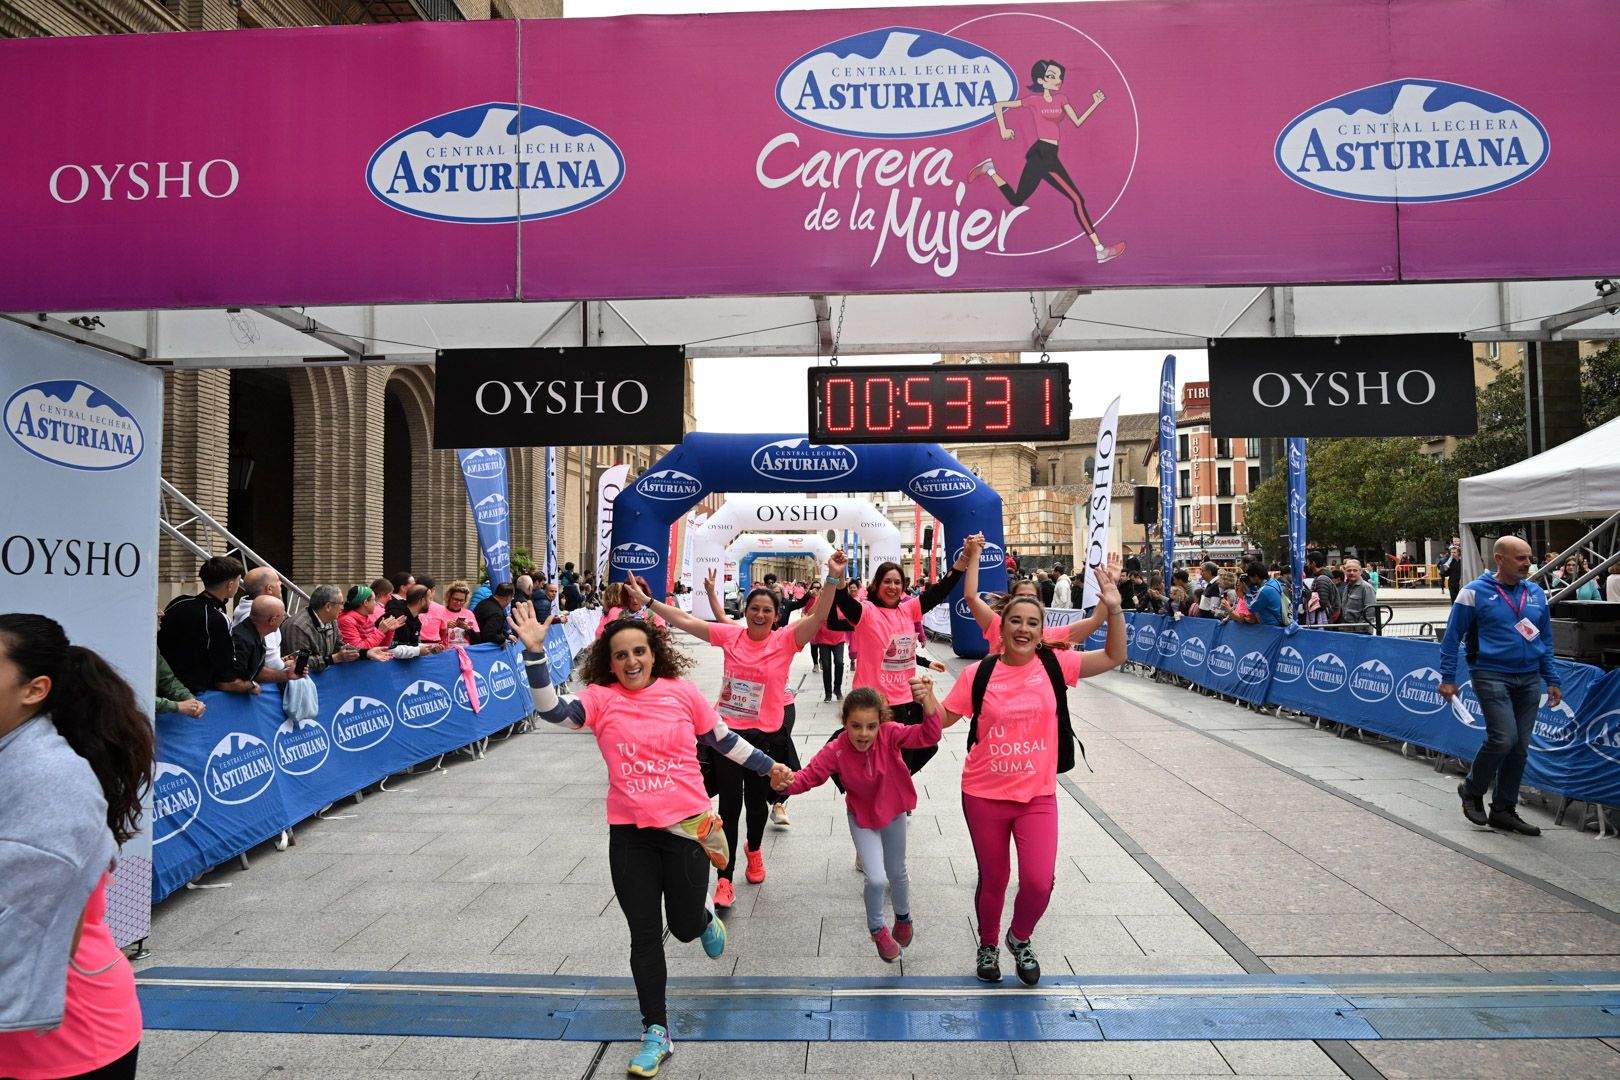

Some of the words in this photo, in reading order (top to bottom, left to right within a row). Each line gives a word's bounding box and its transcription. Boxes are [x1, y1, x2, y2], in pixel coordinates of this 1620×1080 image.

[832, 64, 907, 77] CENTRAL
[914, 64, 991, 76] LECHERA
[794, 70, 999, 112] ASTURIANA
[1338, 120, 1423, 136] CENTRAL
[1432, 119, 1519, 132] LECHERA
[426, 145, 505, 158] CENTRAL
[509, 142, 597, 155] LECHERA
[755, 132, 955, 189] Carrera
[1296, 127, 1530, 173] ASTURIANA
[49, 159, 240, 204] OYSHO
[386, 150, 605, 194] ASTURIANA
[804, 192, 841, 231] de
[849, 192, 876, 231] la
[870, 182, 1031, 278] Mujer
[475, 379, 649, 415] OYSHO
[1186, 387, 1210, 399] TIBU
[1252, 369, 1437, 408] OYSHO
[14, 401, 135, 456] ASTURIANA
[39, 403, 86, 422] CENTRAL
[89, 414, 132, 431] LECHERA
[759, 452, 850, 471] ASTURIANA
[640, 480, 697, 493] ASTURIANA
[914, 481, 972, 493] ASTURIANA
[1088, 429, 1114, 570] OYSHO
[756, 504, 838, 521] OYSHO
[1, 535, 141, 578] OYSHO
[1307, 664, 1344, 685] ASTURIANA
[1351, 672, 1390, 695] ASTURIANA
[402, 697, 449, 722] ASTURIANA
[337, 714, 391, 744] ASTURIANA
[279, 736, 328, 766] ASTURIANA
[616, 743, 636, 758] TU
[989, 738, 1047, 756] DORSAL
[212, 755, 274, 796] ASTURIANA
[621, 758, 684, 777] DORSAL
[990, 759, 1035, 773] SUMA
[626, 774, 676, 794] SUMA
